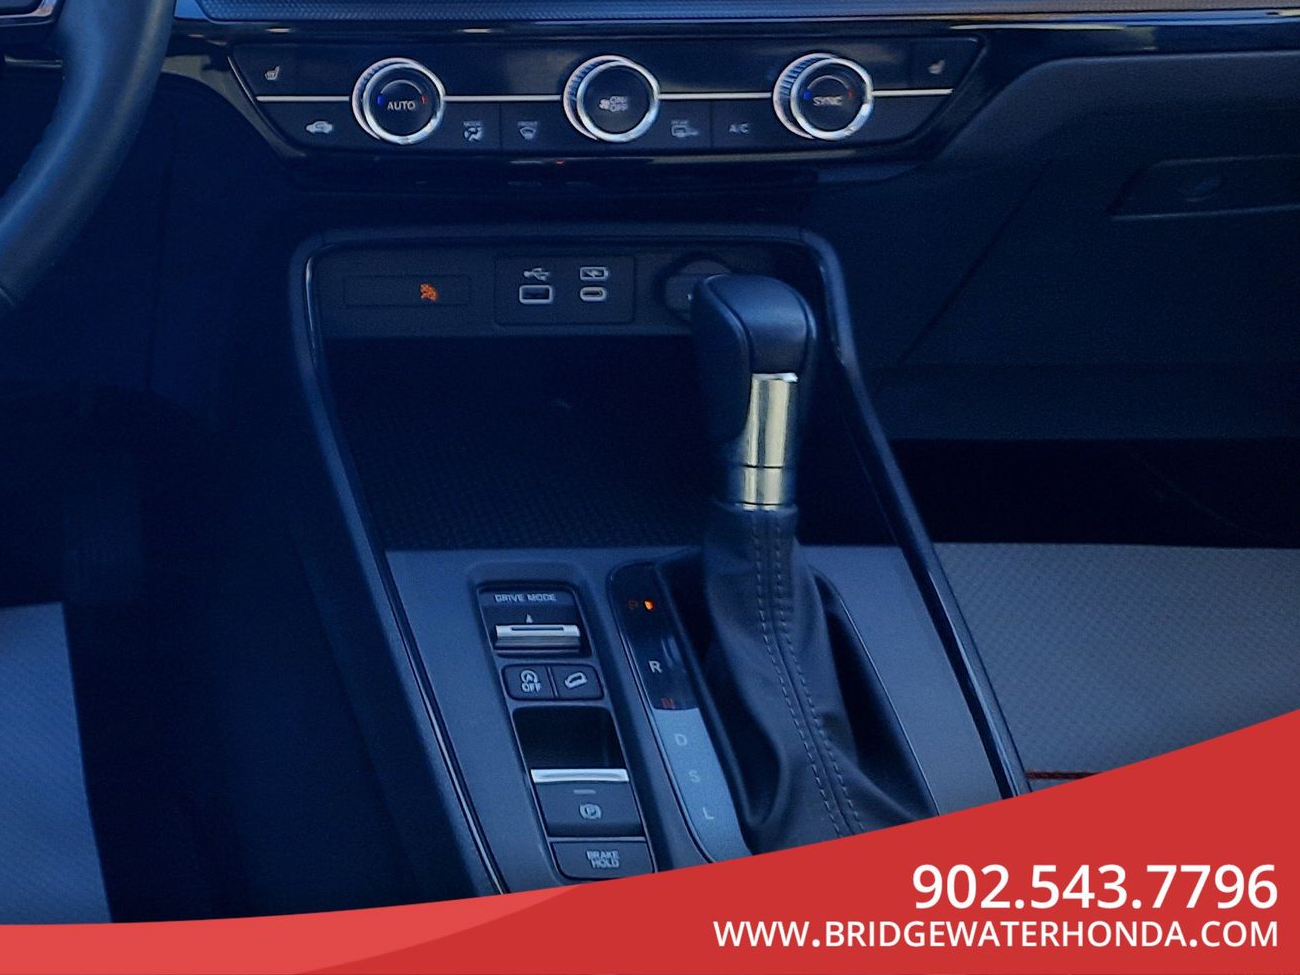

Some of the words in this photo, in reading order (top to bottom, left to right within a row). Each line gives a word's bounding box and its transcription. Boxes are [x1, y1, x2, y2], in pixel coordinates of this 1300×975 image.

[387, 100, 416, 111] AUTO
[813, 96, 843, 106] SYNC
[495, 594, 523, 602] DRIVE
[527, 594, 557, 602] MODE
[649, 660, 662, 674] R
[521, 683, 541, 693] OFF
[675, 734, 687, 746] D
[689, 771, 700, 783] S
[703, 808, 714, 820] L
[587, 851, 619, 859] BRAKE
[591, 858, 620, 868] HOLD
